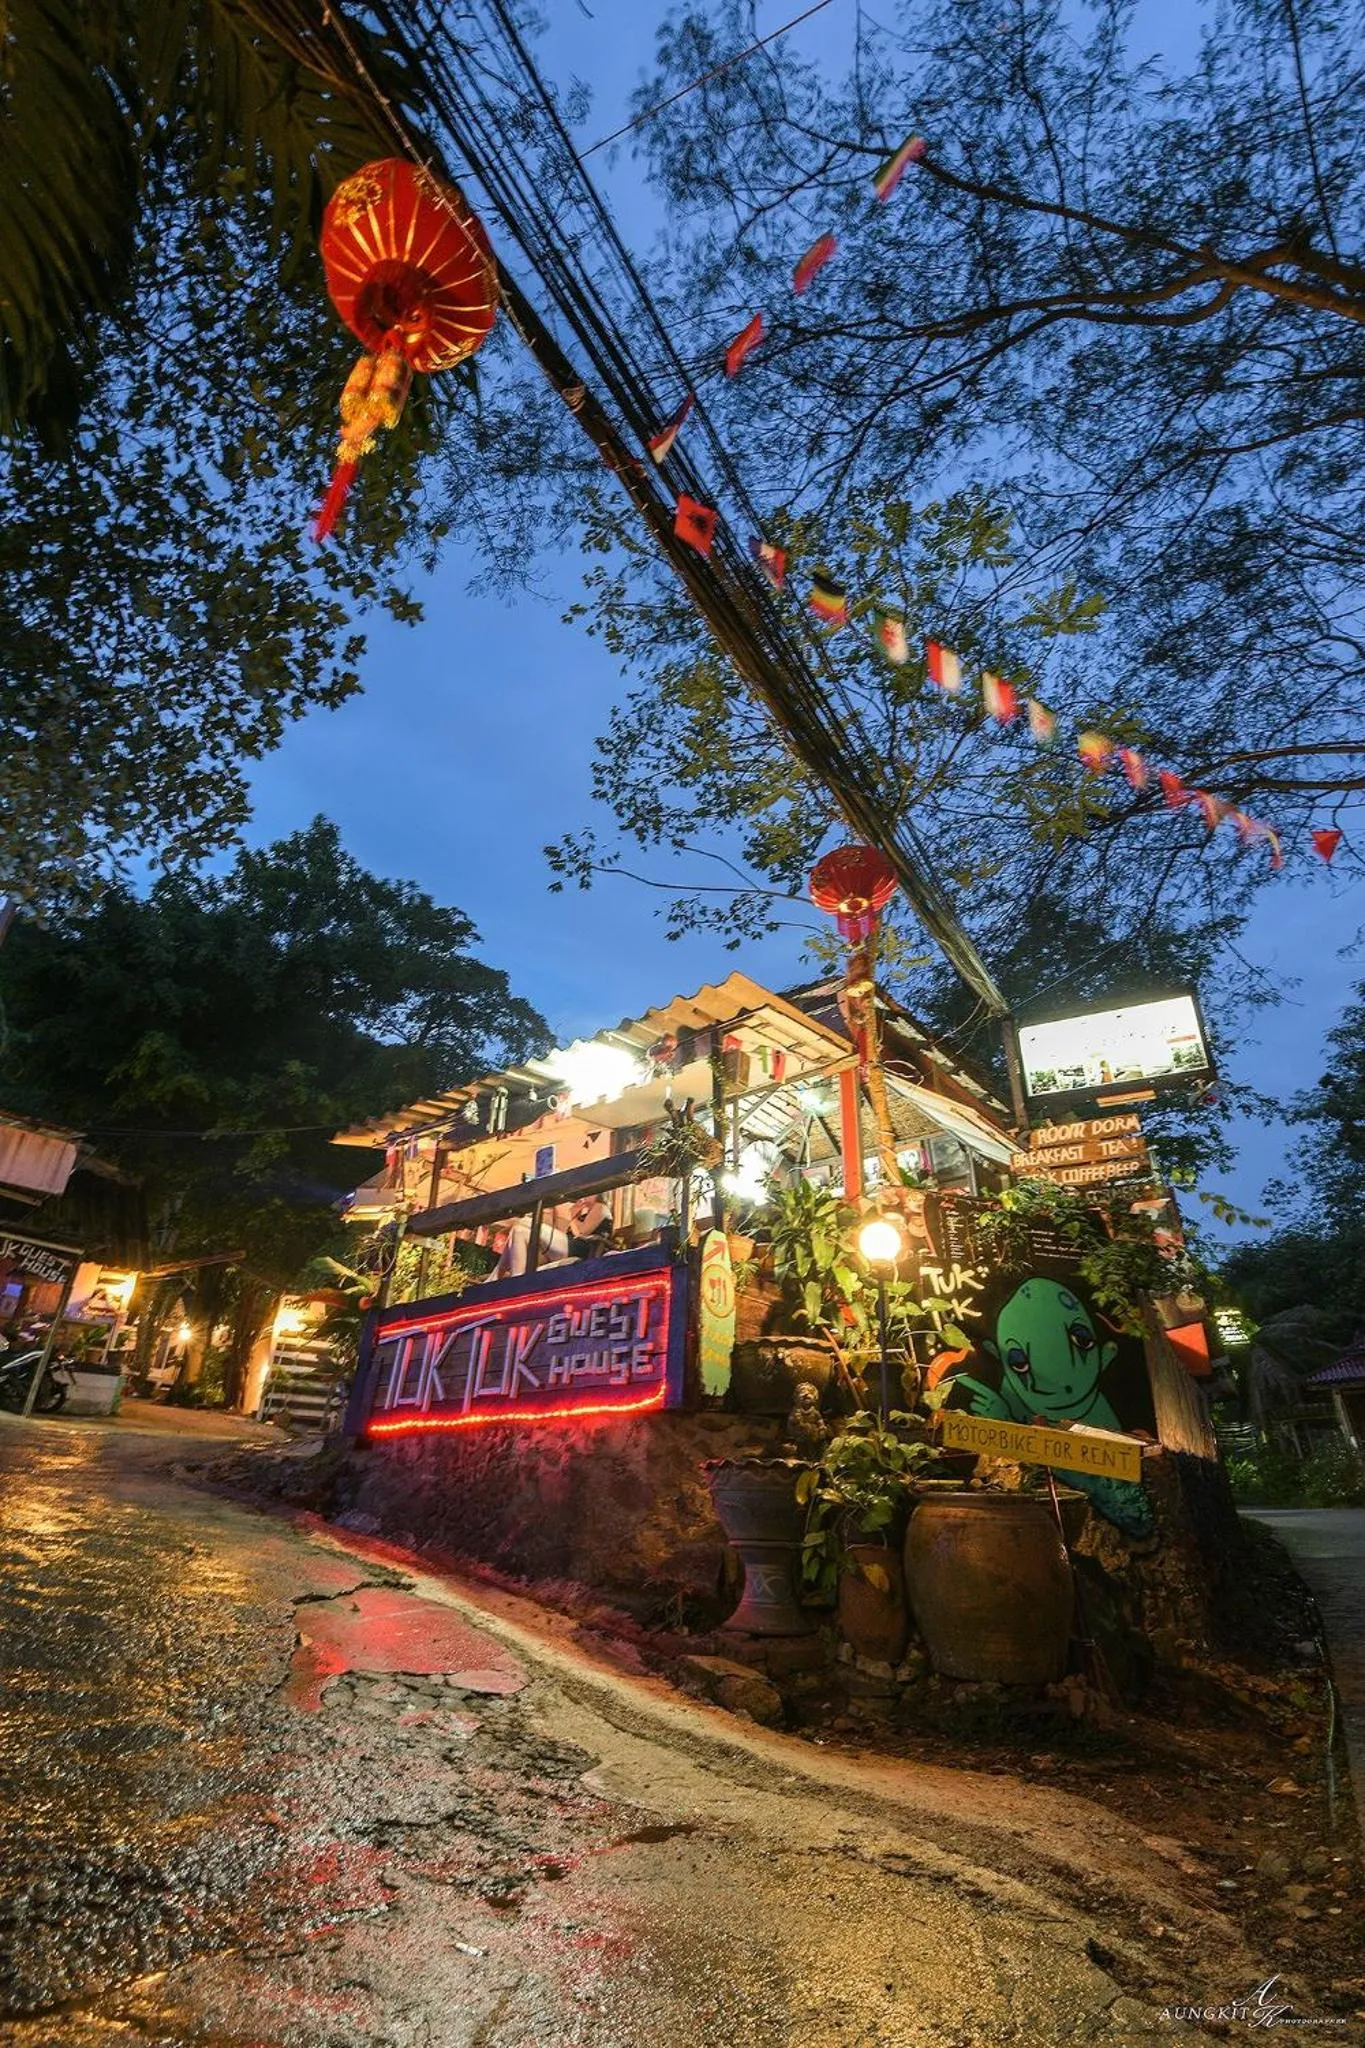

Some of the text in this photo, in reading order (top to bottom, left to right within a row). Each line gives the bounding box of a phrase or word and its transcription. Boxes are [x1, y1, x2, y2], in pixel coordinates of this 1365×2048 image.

[1037, 1114, 1141, 1145] ROOM DORM
[1012, 1145, 1085, 1168] BREAKFAST
[1060, 1165, 1106, 1184] COFFEE
[919, 1263, 985, 1295] TUK
[547, 1290, 658, 1343] GUEST
[548, 1342, 655, 1386] HOUSE
[949, 1421, 1131, 1471] MOTORBIKE FOR RENT
